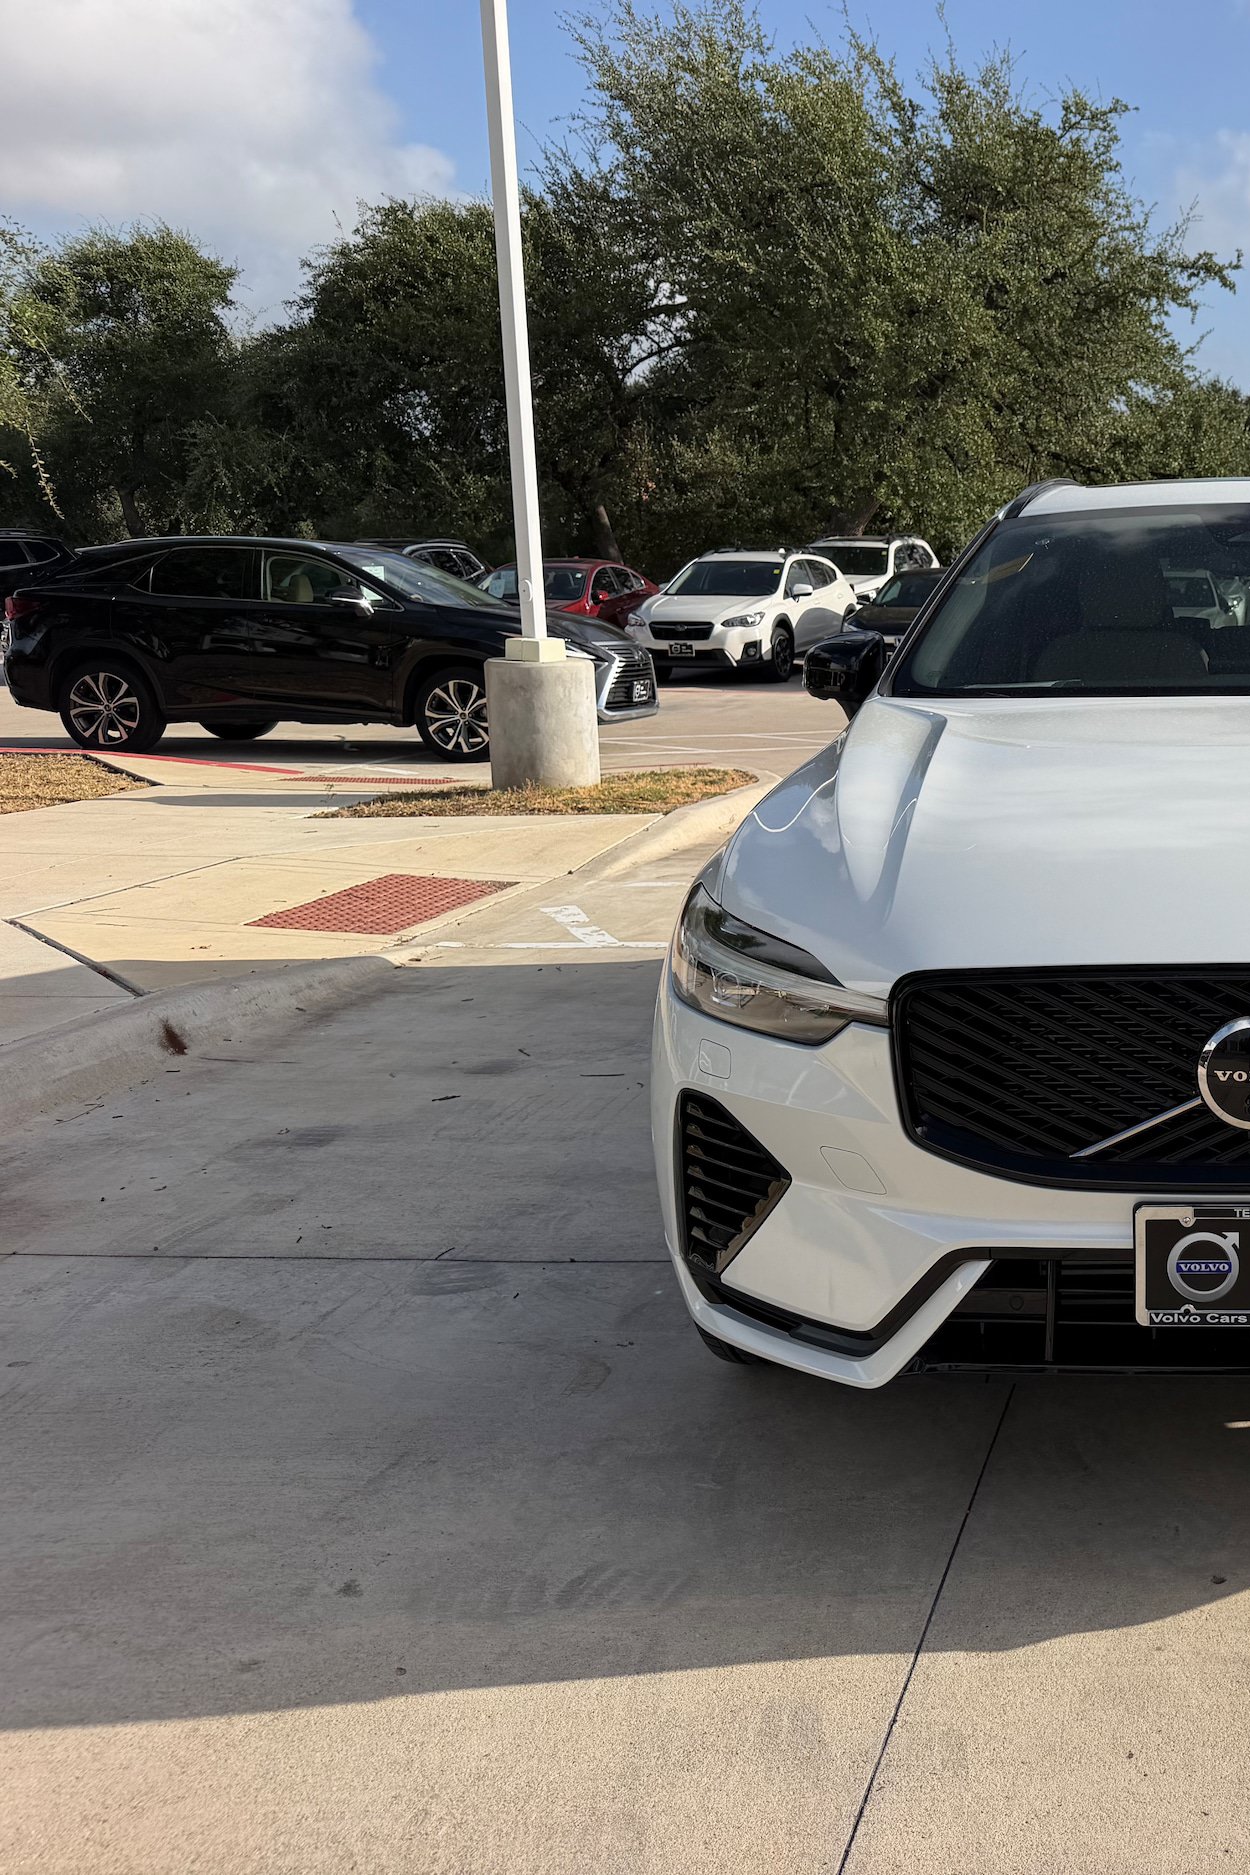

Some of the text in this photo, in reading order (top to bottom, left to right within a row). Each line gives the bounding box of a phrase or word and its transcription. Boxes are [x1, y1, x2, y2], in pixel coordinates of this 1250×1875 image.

[1179, 1263, 1229, 1272] VOLVO
[1150, 1313, 1201, 1323] Volvo
[1206, 1313, 1248, 1323] Cars
